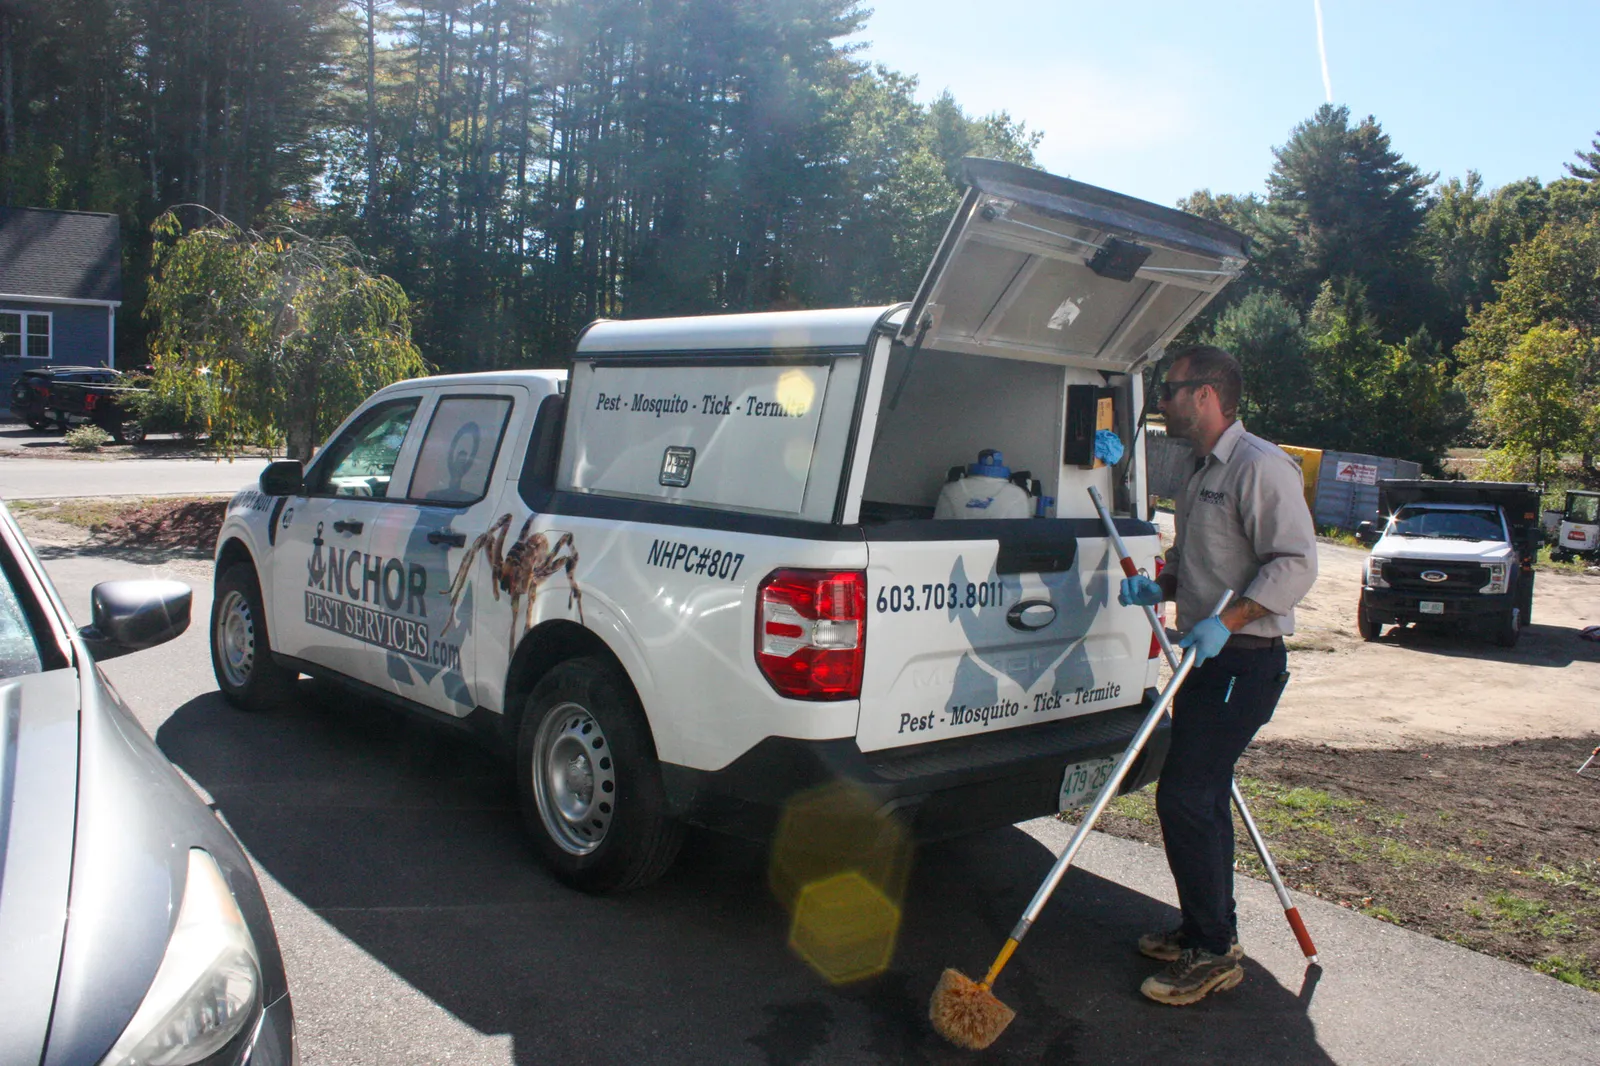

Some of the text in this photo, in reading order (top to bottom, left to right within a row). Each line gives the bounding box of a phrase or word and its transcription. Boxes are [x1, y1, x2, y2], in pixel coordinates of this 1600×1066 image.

[596, 393, 621, 411] Pest
[631, 394, 688, 417] Mosquito
[702, 395, 732, 416] Tick
[307, 543, 428, 618] ANCHOR
[647, 539, 745, 581] NHPC#807
[876, 581, 1003, 613] 603.703.8011
[307, 592, 341, 629] PEST
[345, 603, 428, 657] SERVICES
[898, 713, 935, 734] Pest
[950, 701, 1019, 727] Mosquito
[1034, 693, 1062, 713] Tick
[1075, 682, 1121, 705] Termite
[1063, 770, 1087, 795] 479
[1092, 761, 1119, 790] 252
